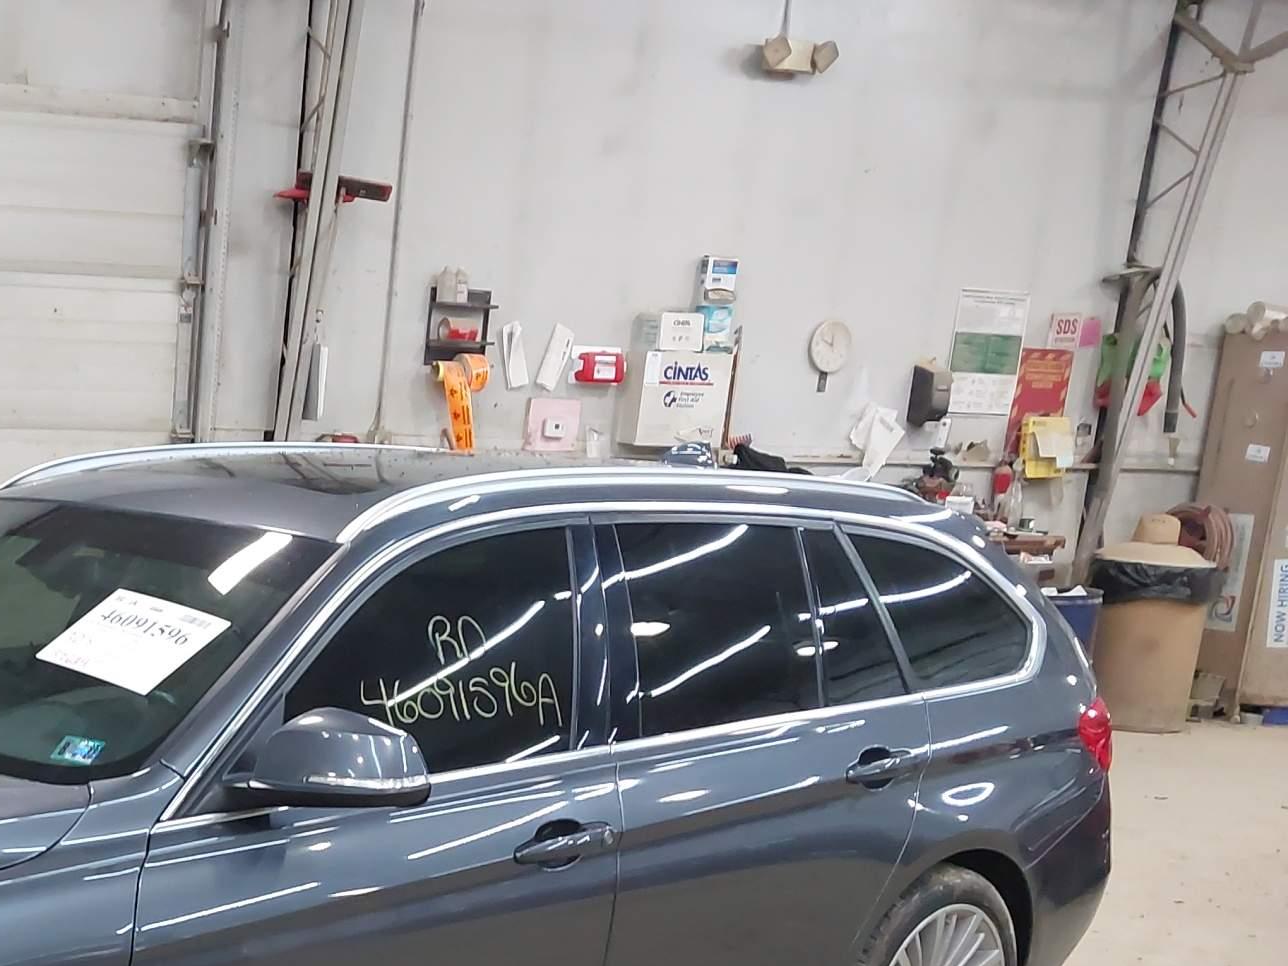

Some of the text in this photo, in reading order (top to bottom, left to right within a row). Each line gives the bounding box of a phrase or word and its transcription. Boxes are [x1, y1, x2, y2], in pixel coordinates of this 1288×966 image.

[1056, 317, 1078, 336] SDS
[1273, 564, 1288, 643] NOW HIRING
[360, 661, 563, 728] 46091596A
